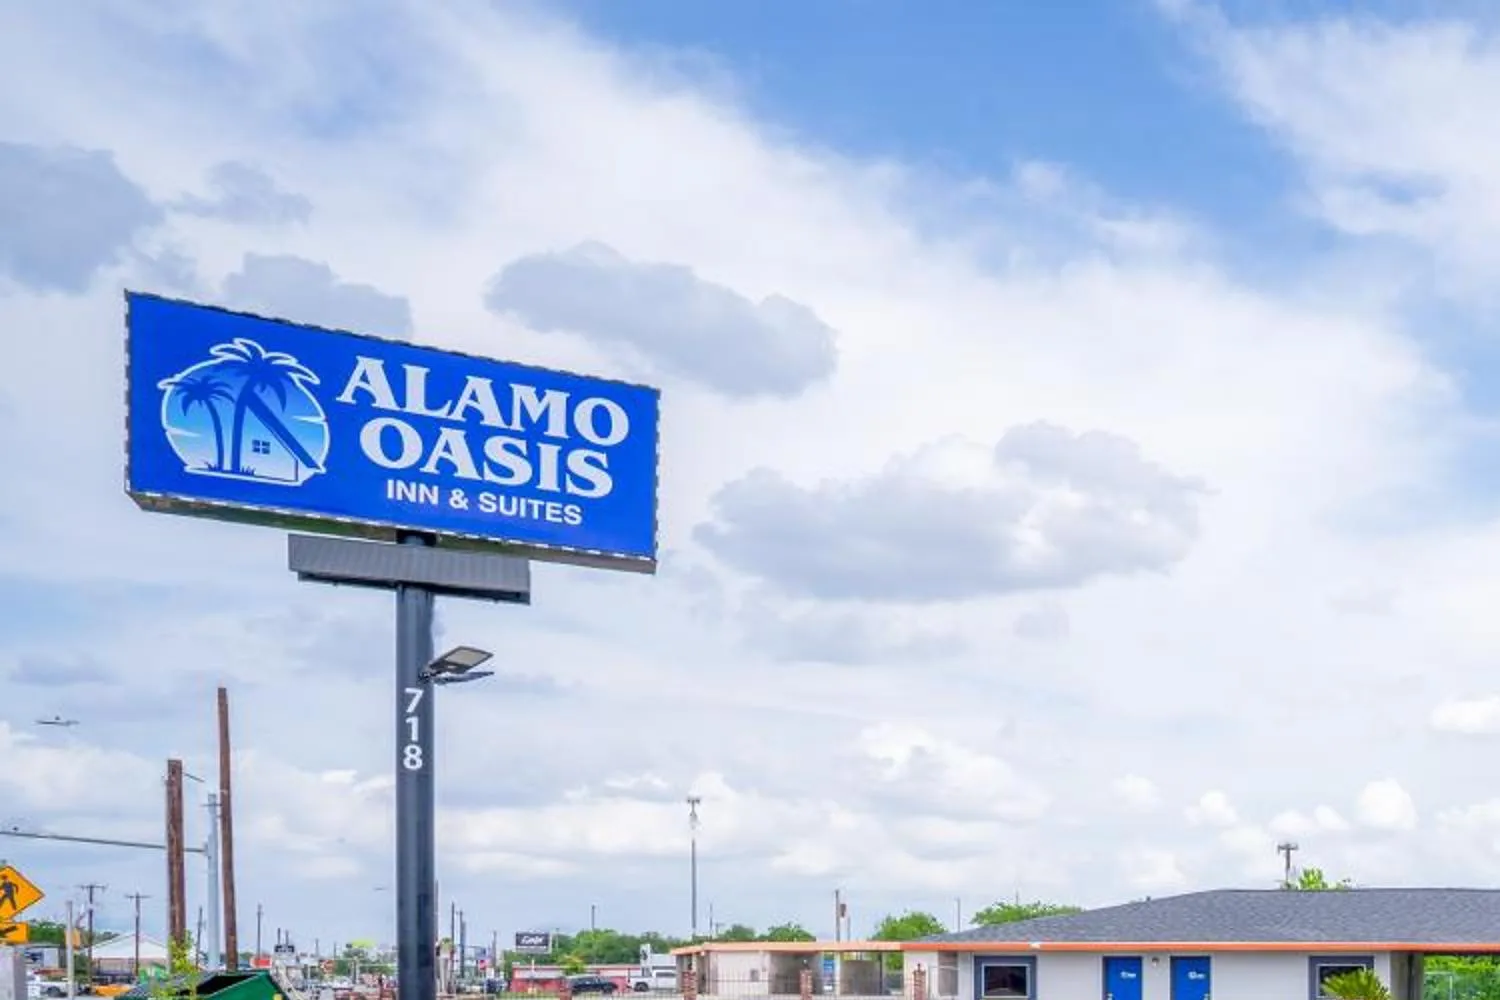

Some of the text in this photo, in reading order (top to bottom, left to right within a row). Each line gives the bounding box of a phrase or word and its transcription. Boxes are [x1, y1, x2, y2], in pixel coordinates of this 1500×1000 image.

[335, 355, 630, 446] ALAMO
[359, 416, 614, 499] OASIS
[386, 479, 583, 526] INN & SUITES
[403, 687, 424, 770] 718
